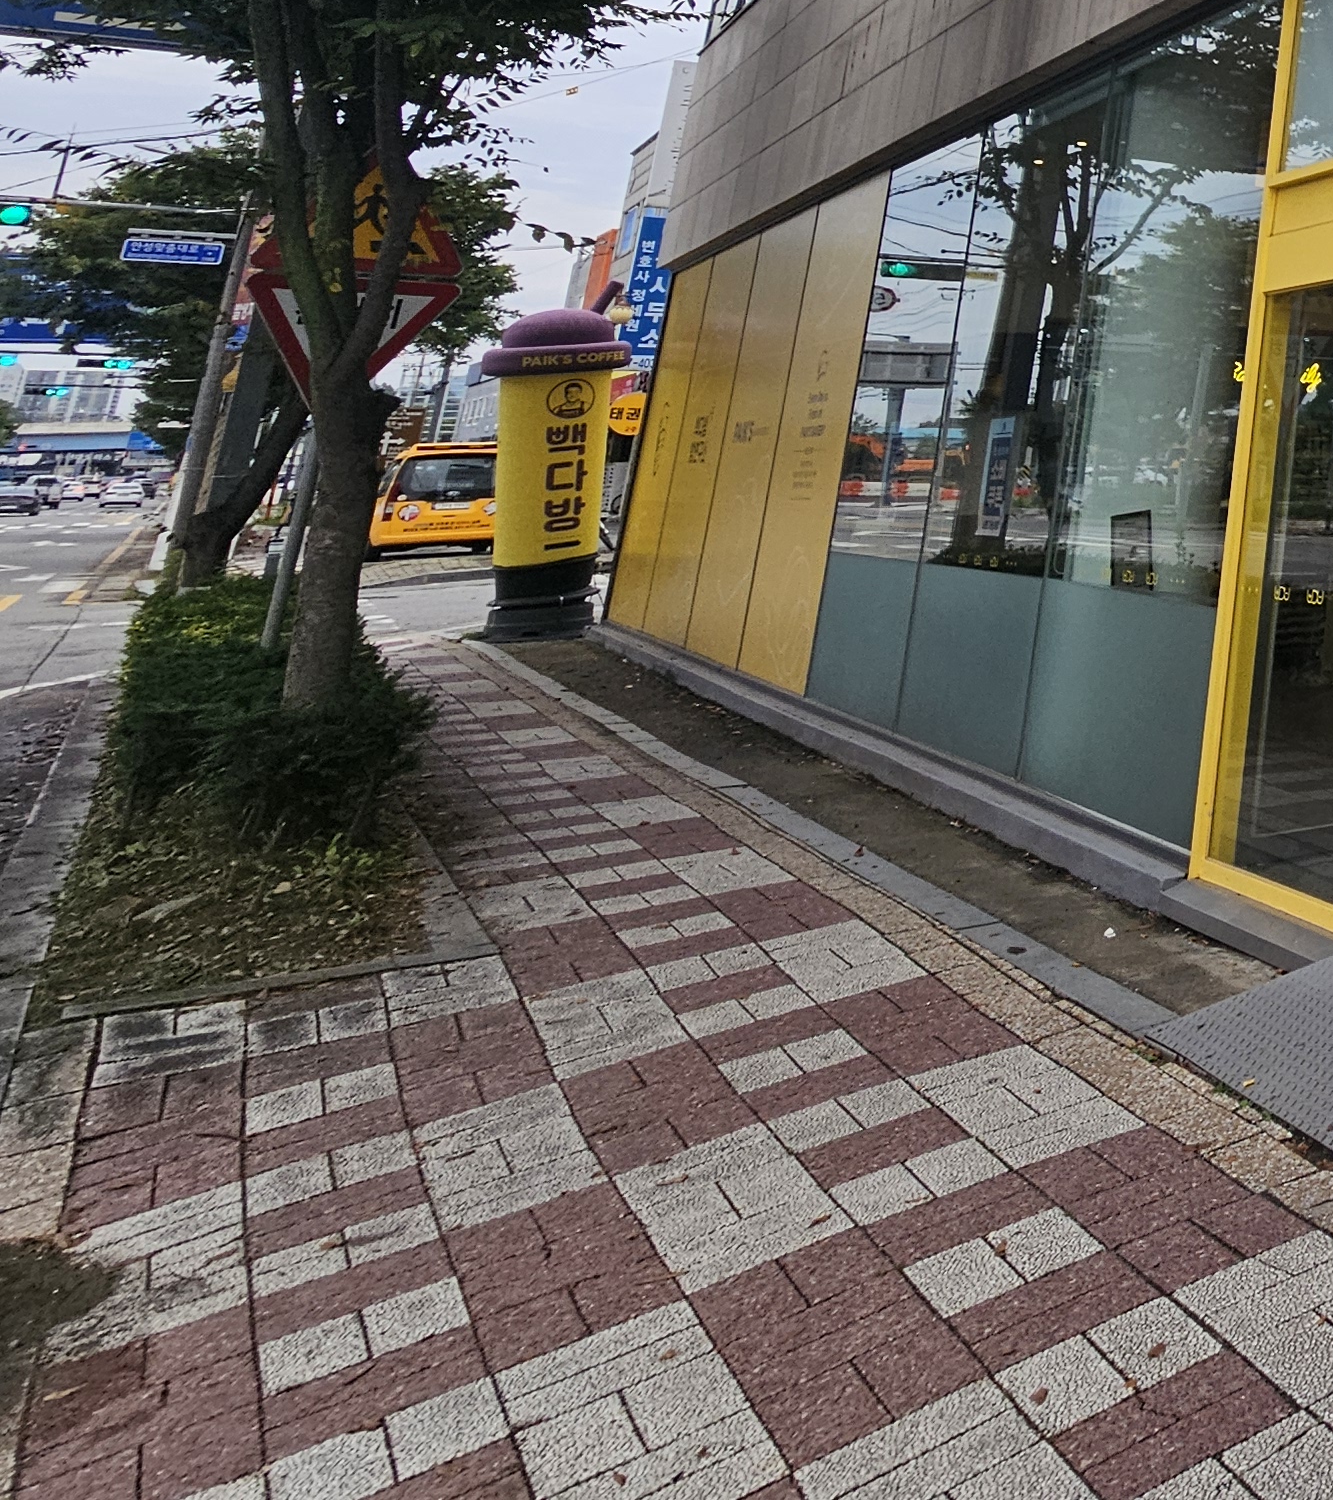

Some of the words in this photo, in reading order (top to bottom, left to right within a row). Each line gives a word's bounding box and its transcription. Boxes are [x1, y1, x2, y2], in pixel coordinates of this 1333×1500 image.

[634, 240, 656, 284] 변호사
[521, 354, 573, 368] PAIK'S
[576, 350, 626, 364] COFFEE
[543, 422, 588, 533] 빽다방
